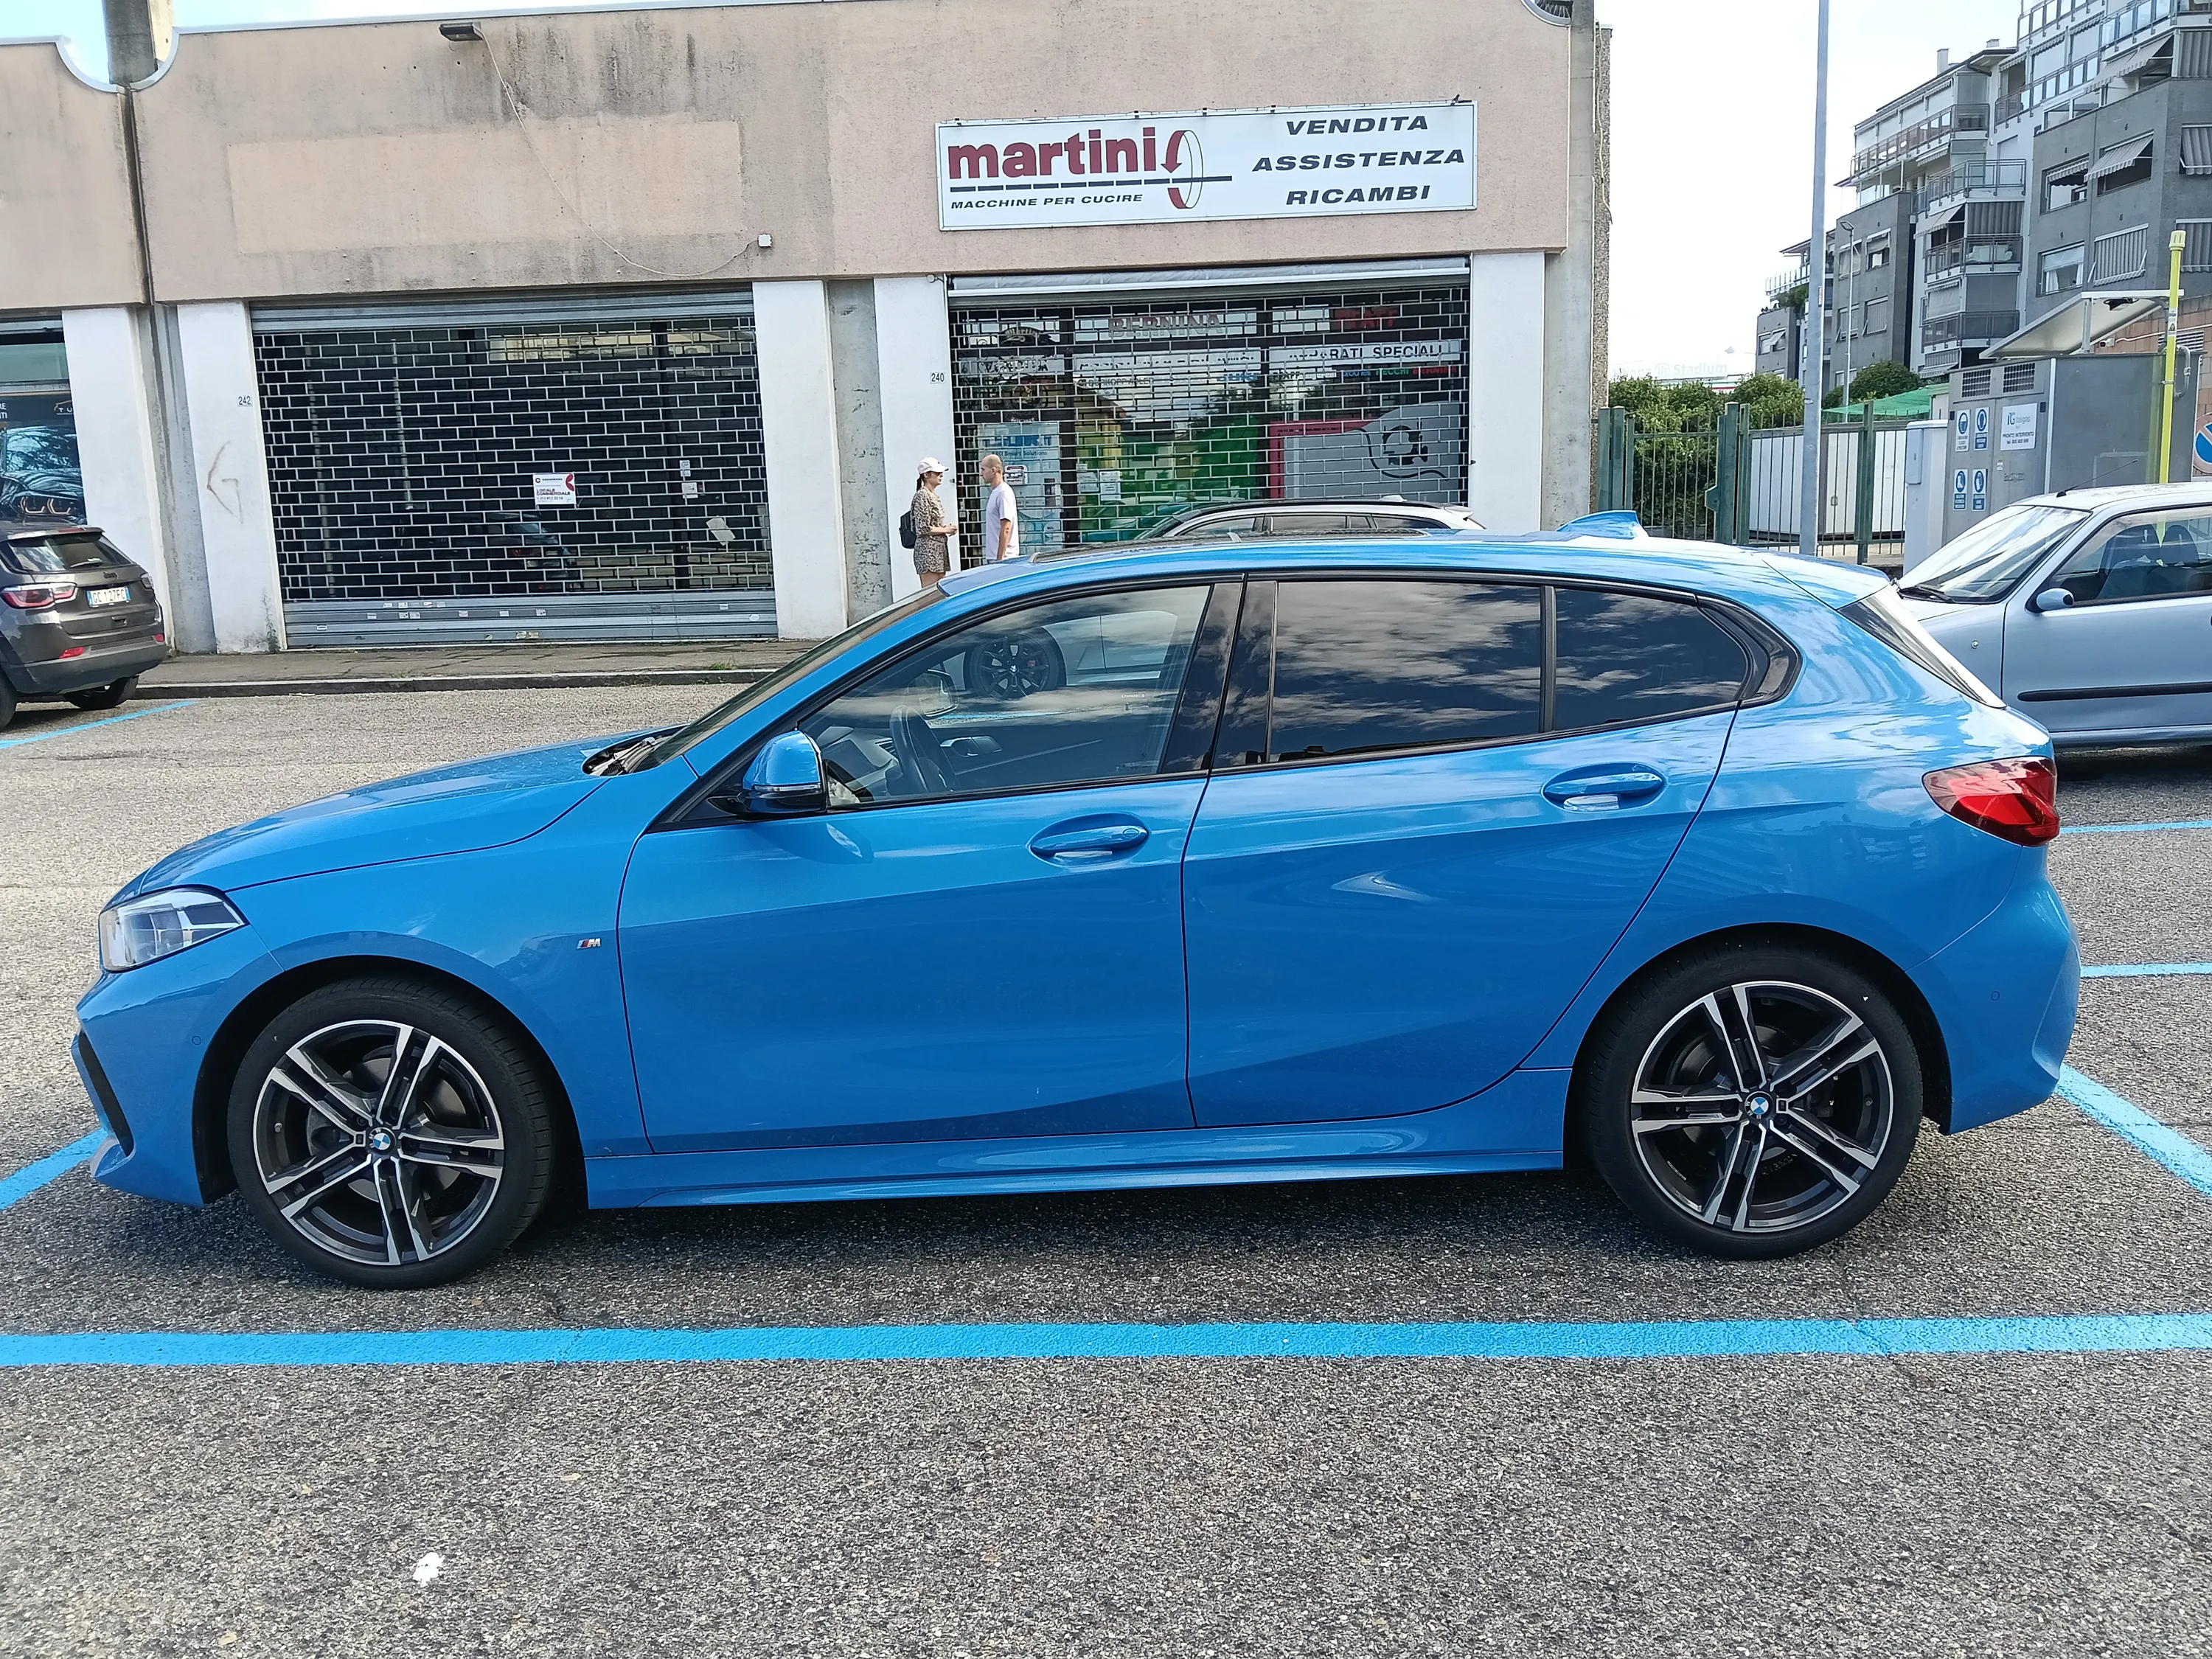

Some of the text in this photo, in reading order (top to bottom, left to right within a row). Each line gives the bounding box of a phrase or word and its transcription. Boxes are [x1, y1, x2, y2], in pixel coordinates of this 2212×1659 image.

[1286, 115, 1428, 135] VENDITA
[947, 128, 1156, 179] martini
[1252, 149, 1465, 172] ASSISTENZA
[951, 193, 1144, 209] MACCHINE PER CUCIRE
[1286, 185, 1430, 205] RICAMBI
[1107, 313, 1224, 338] BERNINA
[1373, 344, 1442, 359] SPECIALI
[931, 372, 945, 382] 240
[238, 395, 251, 406] 242
